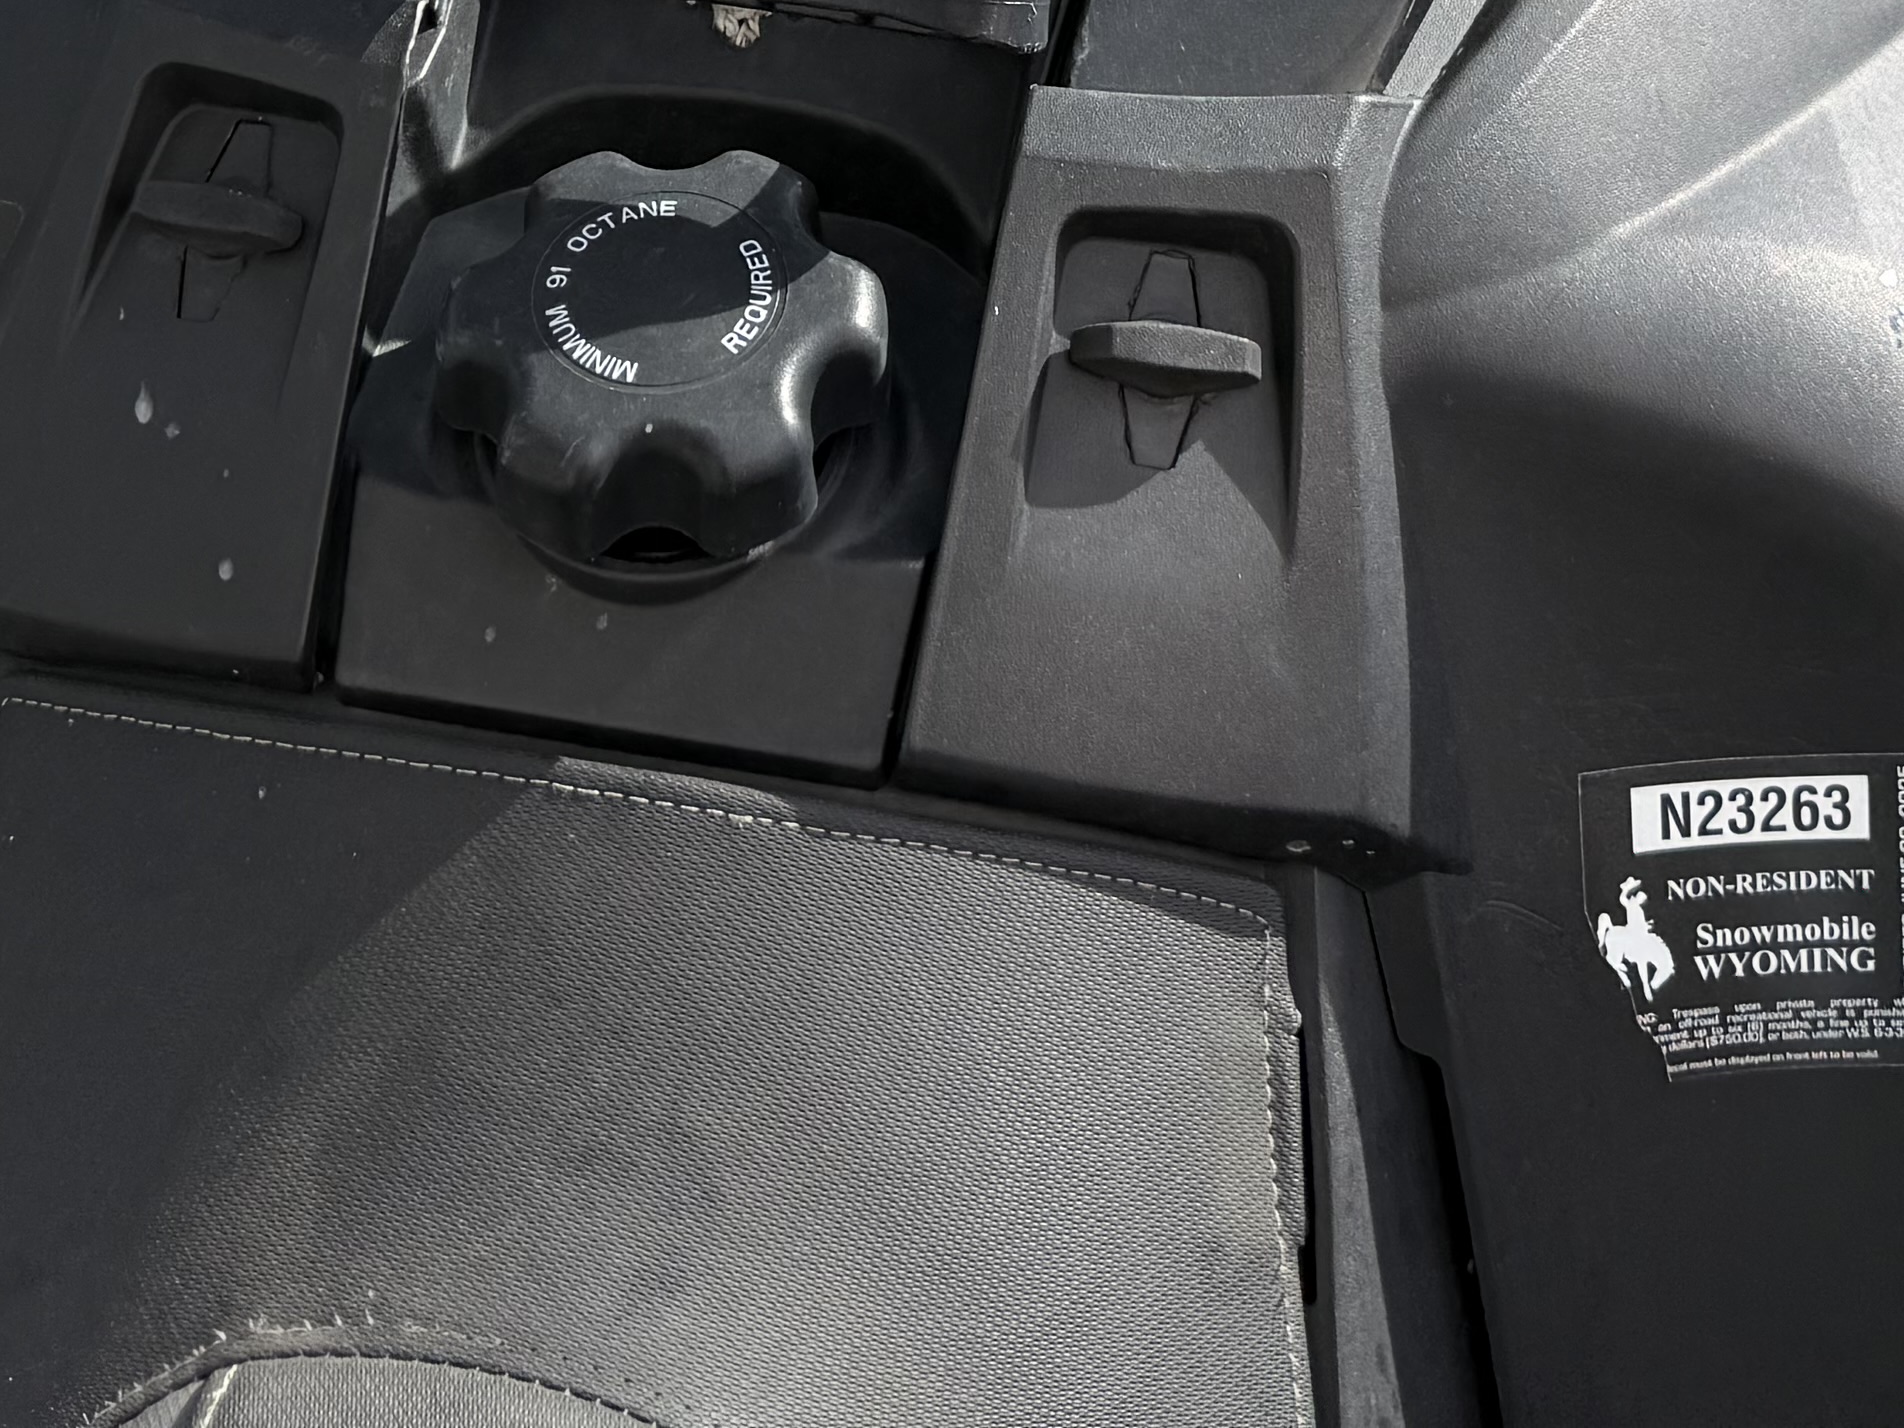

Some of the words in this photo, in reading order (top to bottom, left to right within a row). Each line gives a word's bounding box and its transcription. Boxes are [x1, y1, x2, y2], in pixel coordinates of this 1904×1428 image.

[567, 200, 678, 253] OCTANE
[546, 266, 572, 288] 91
[720, 239, 773, 354] REQUIRED
[545, 305, 639, 382] MINIMUM
[1660, 784, 1852, 841] N23263
[1667, 868, 1876, 901] NON-RESIDENT
[1695, 915, 1876, 948] Snowmobile
[1694, 947, 1876, 981] WYOMING
